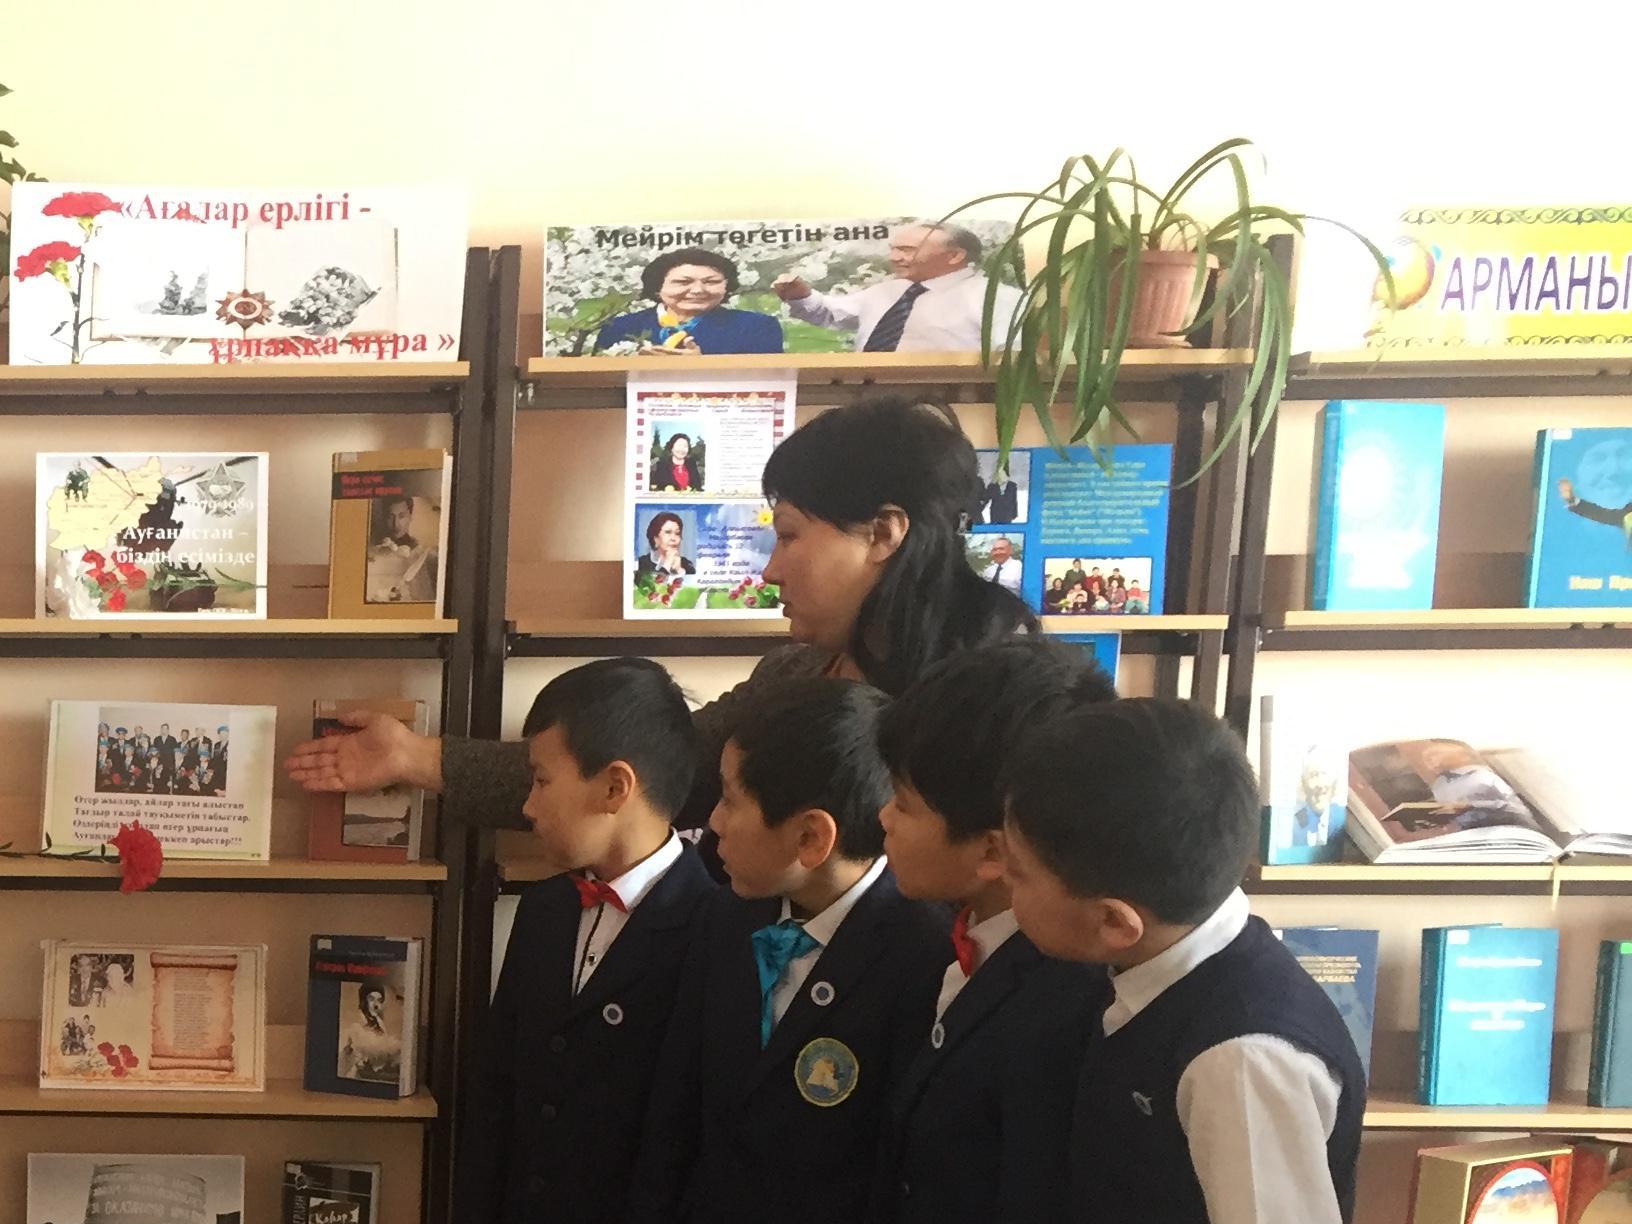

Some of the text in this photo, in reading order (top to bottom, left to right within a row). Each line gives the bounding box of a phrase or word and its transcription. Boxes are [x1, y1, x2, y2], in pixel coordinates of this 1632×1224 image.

[259, 192, 349, 229] ерлігі
[595, 223, 889, 250] Мейрім төгетін ана
[122, 527, 233, 545] Ауғанистан
[117, 546, 256, 566] біздің есімізде
